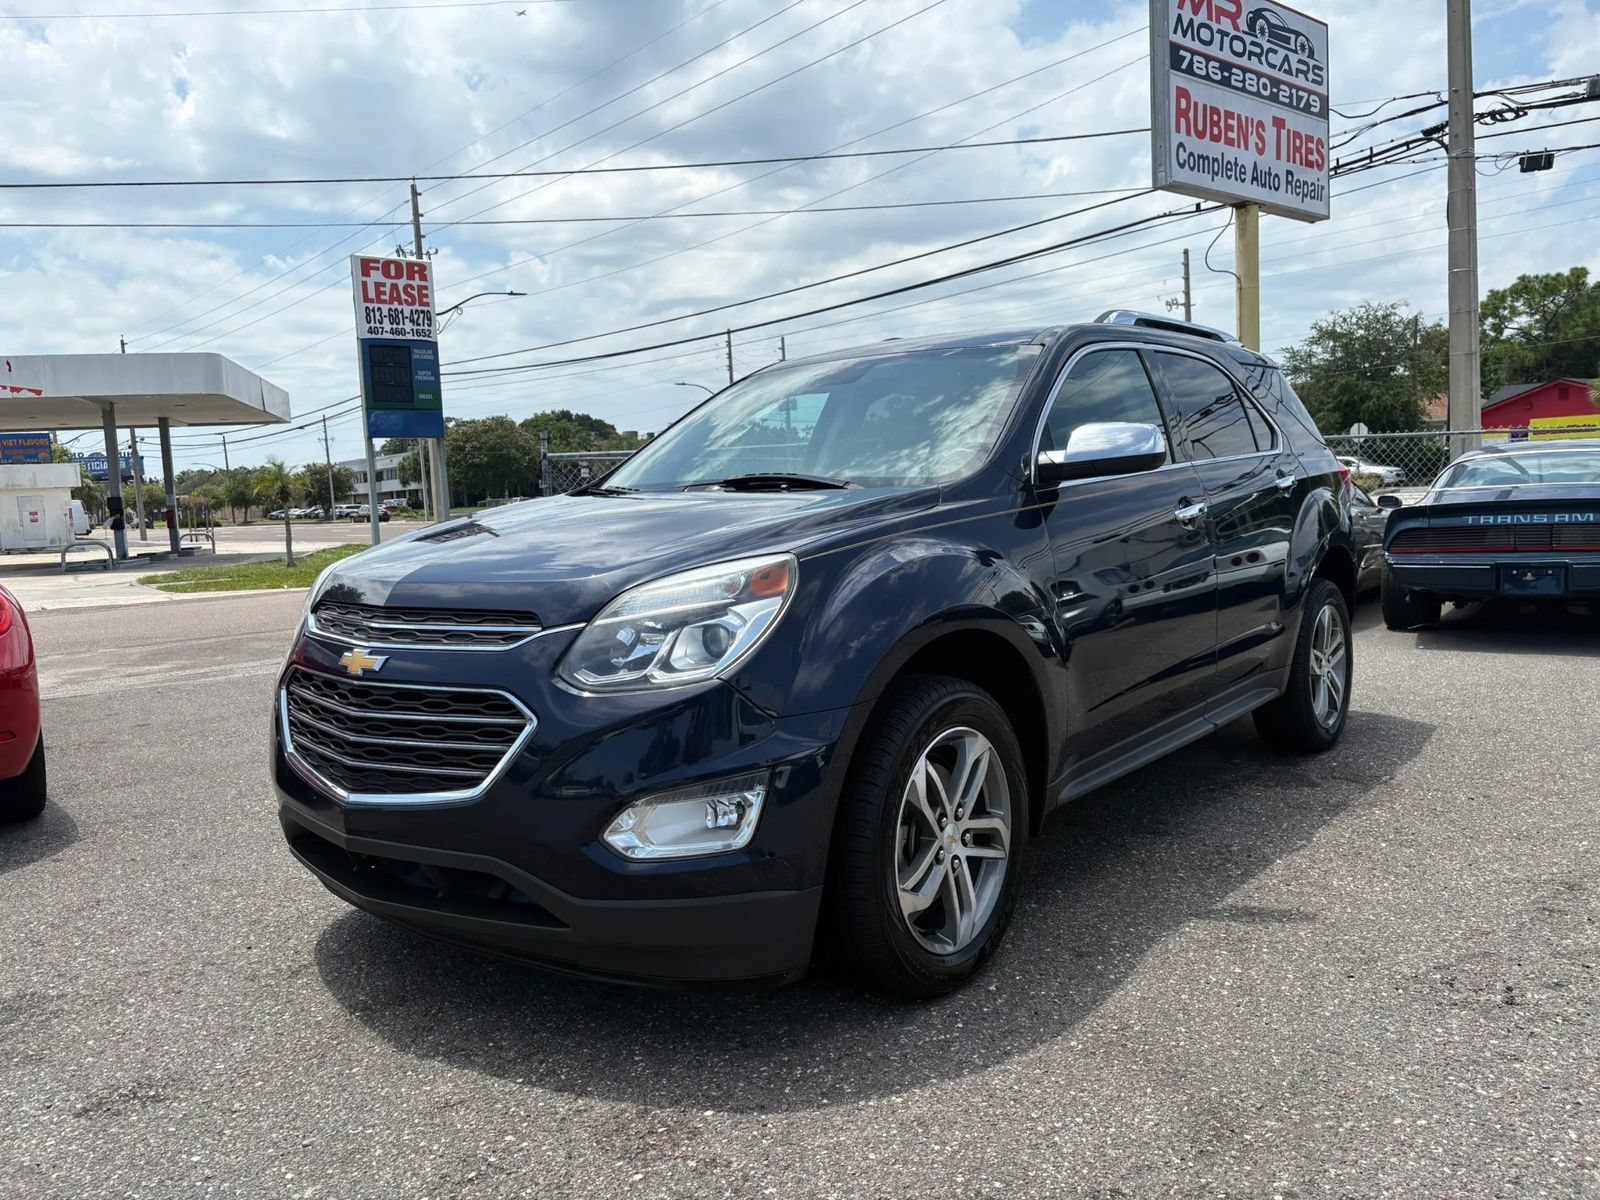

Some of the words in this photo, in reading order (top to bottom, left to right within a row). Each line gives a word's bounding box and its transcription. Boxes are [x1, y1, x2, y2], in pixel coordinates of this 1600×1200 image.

[1173, 13, 1324, 87] MOTORCARS
[1178, 50, 1321, 113] 786-280-2179
[1175, 85, 1266, 157] RUBEN'S
[1272, 115, 1325, 172] TIRES
[1176, 141, 1247, 183] Complete
[1250, 161, 1281, 192] Auto
[1285, 169, 1325, 203] Repair
[360, 258, 429, 282] FOR
[361, 281, 430, 307] LEASE
[365, 306, 432, 328] 813-681-4279
[367, 326, 432, 338] 407-460-1652
[19, 438, 49, 446] FLAVORS
[1463, 514, 1548, 525] TRANS
[1554, 513, 1595, 523] AM
